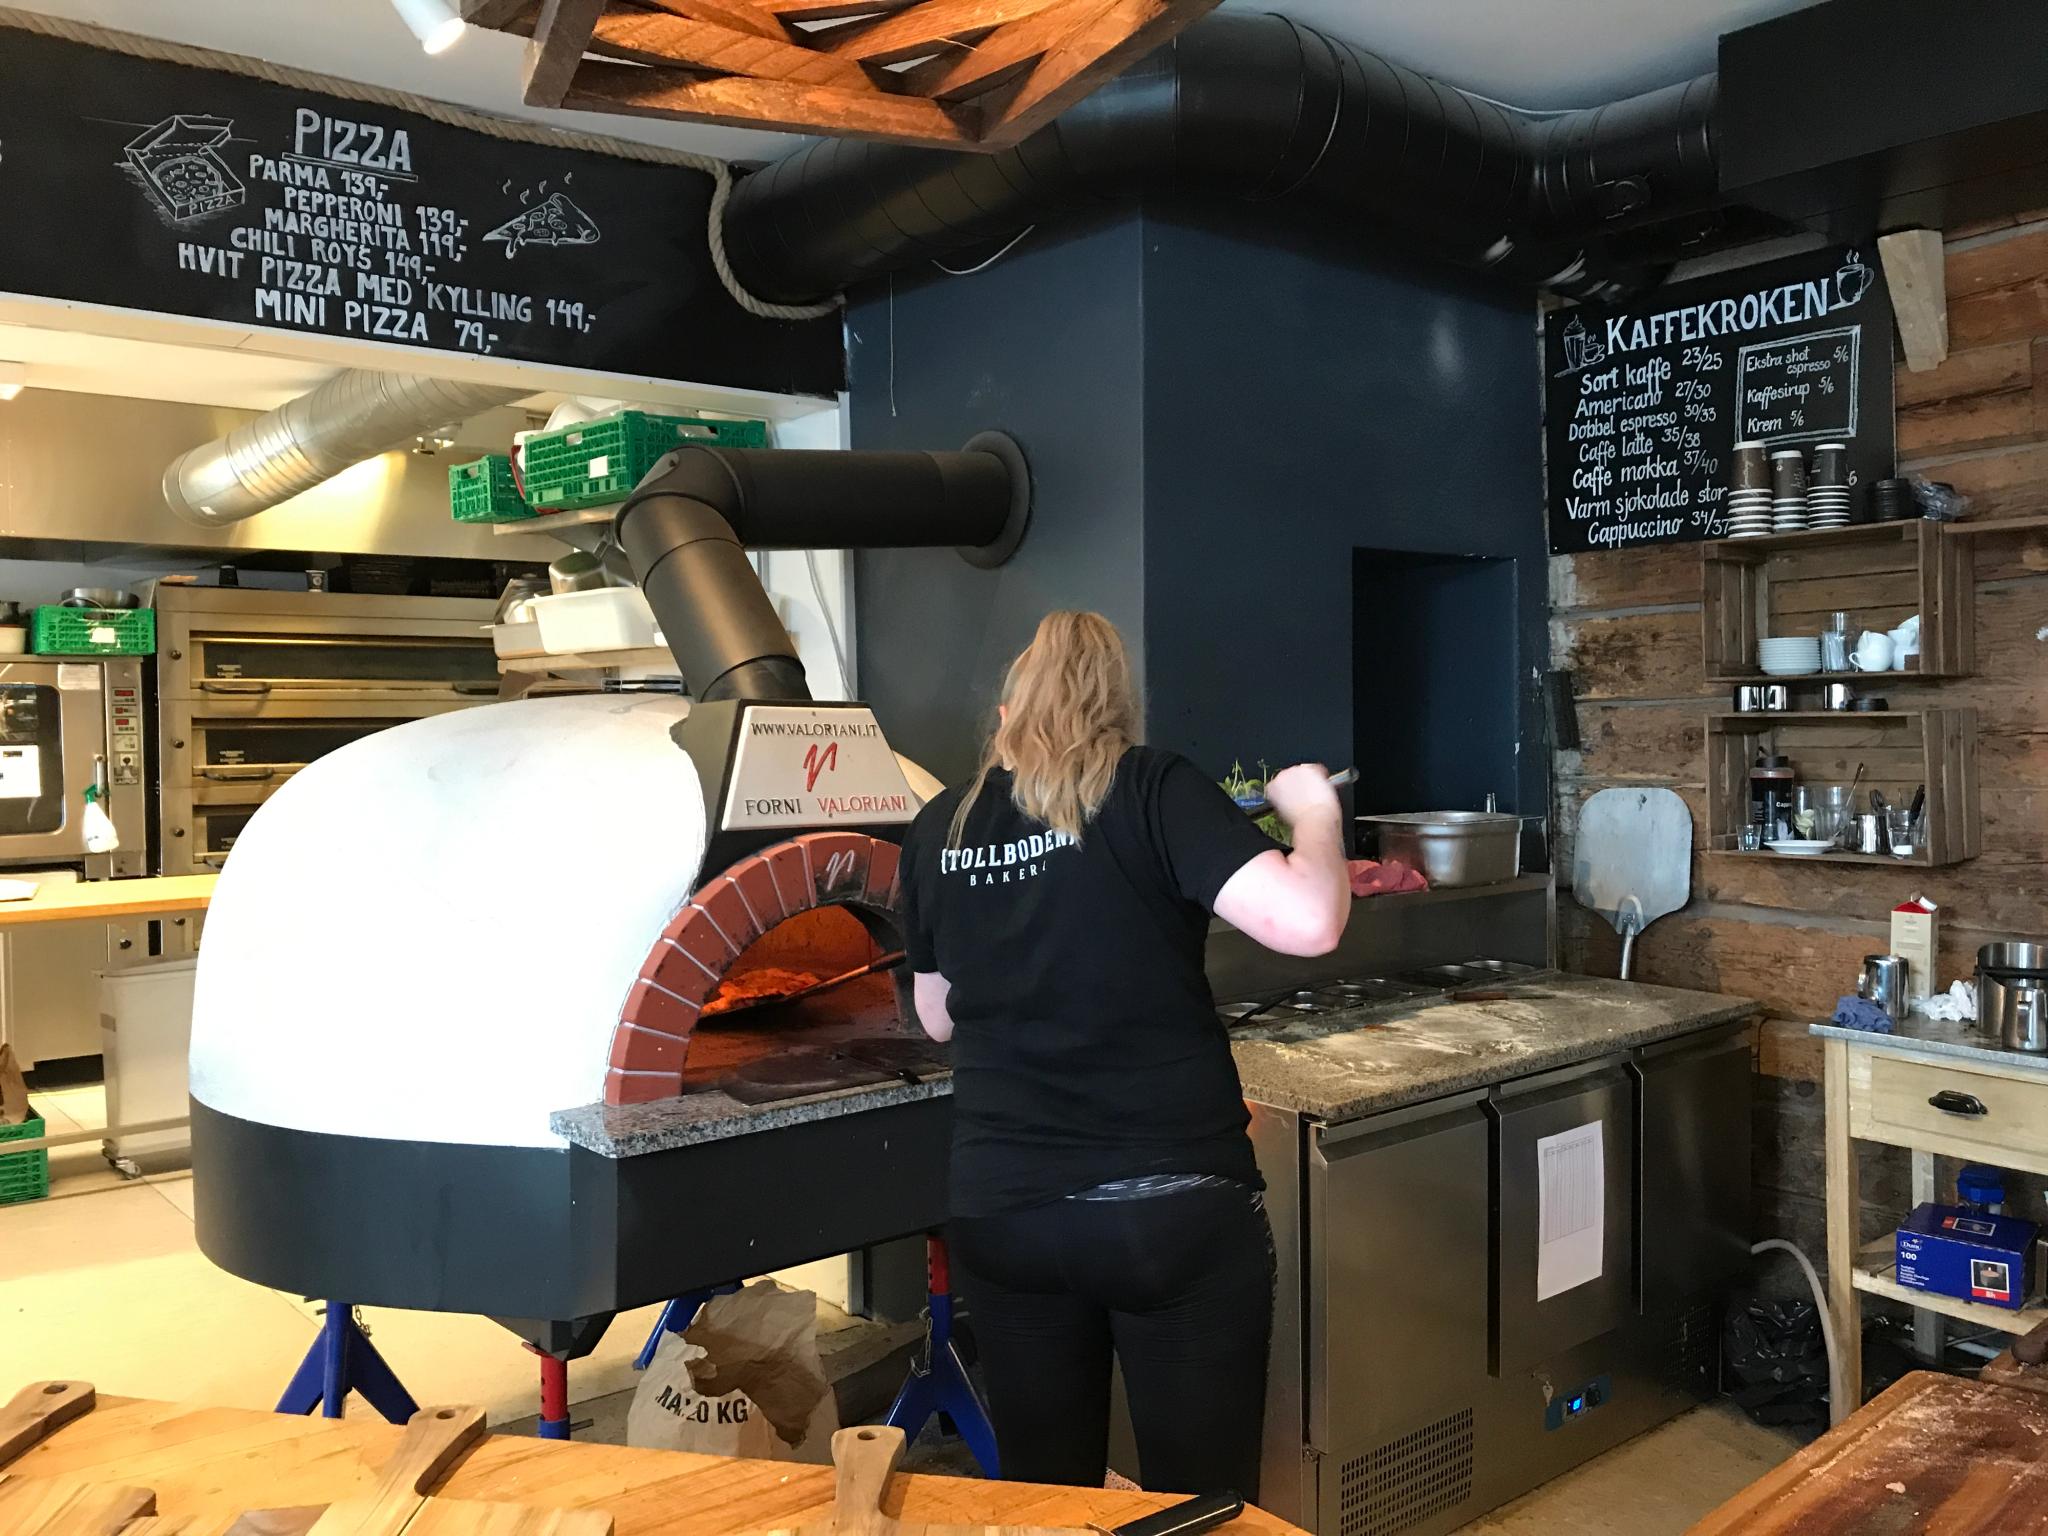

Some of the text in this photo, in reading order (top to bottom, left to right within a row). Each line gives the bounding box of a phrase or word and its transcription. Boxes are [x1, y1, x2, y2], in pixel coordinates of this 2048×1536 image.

[295, 107, 412, 172] PIZZA
[250, 154, 389, 201] PARMA 139,-
[188, 194, 237, 216] PIZZA
[284, 186, 469, 237] PEPPERONI 139,-
[264, 207, 411, 250] MARGHERITA
[230, 227, 295, 258] CHILI
[385, 251, 436, 285] 149,-
[178, 242, 597, 333] HVIT PIZZA MED KYLLING 149,-
[255, 288, 499, 354] MINI PIZZA 79,-
[1605, 278, 1830, 355] KAFFEKROKEN
[1580, 345, 1723, 395] Sort kaffe 23/25
[1746, 344, 1849, 372] Ekstra shot 5/6
[1786, 360, 1831, 378] espresso
[1574, 379, 1711, 419] Americano 27/30
[1747, 375, 1835, 411] Kaffesirup 5/6
[1568, 402, 1717, 441] Dobbel espresso 30/33
[1747, 409, 1805, 433] Krem 5/6
[1579, 425, 1701, 466] Caffe latte 35/38
[1572, 466, 1613, 496] Caffe
[1620, 454, 1680, 483] mokka
[1683, 449, 1719, 475] 37/40
[1565, 496, 1610, 520] Varm
[1615, 478, 1689, 522] sjokolade
[1697, 479, 1728, 503] stor
[1588, 508, 1731, 549] Cappuccino 34/37
[751, 722, 878, 738] WWW.VALORIANI.IT
[745, 795, 908, 816] FORNI VALORIANI
[1901, 1252, 1917, 1260] 100
[717, 1398, 747, 1424] KG
